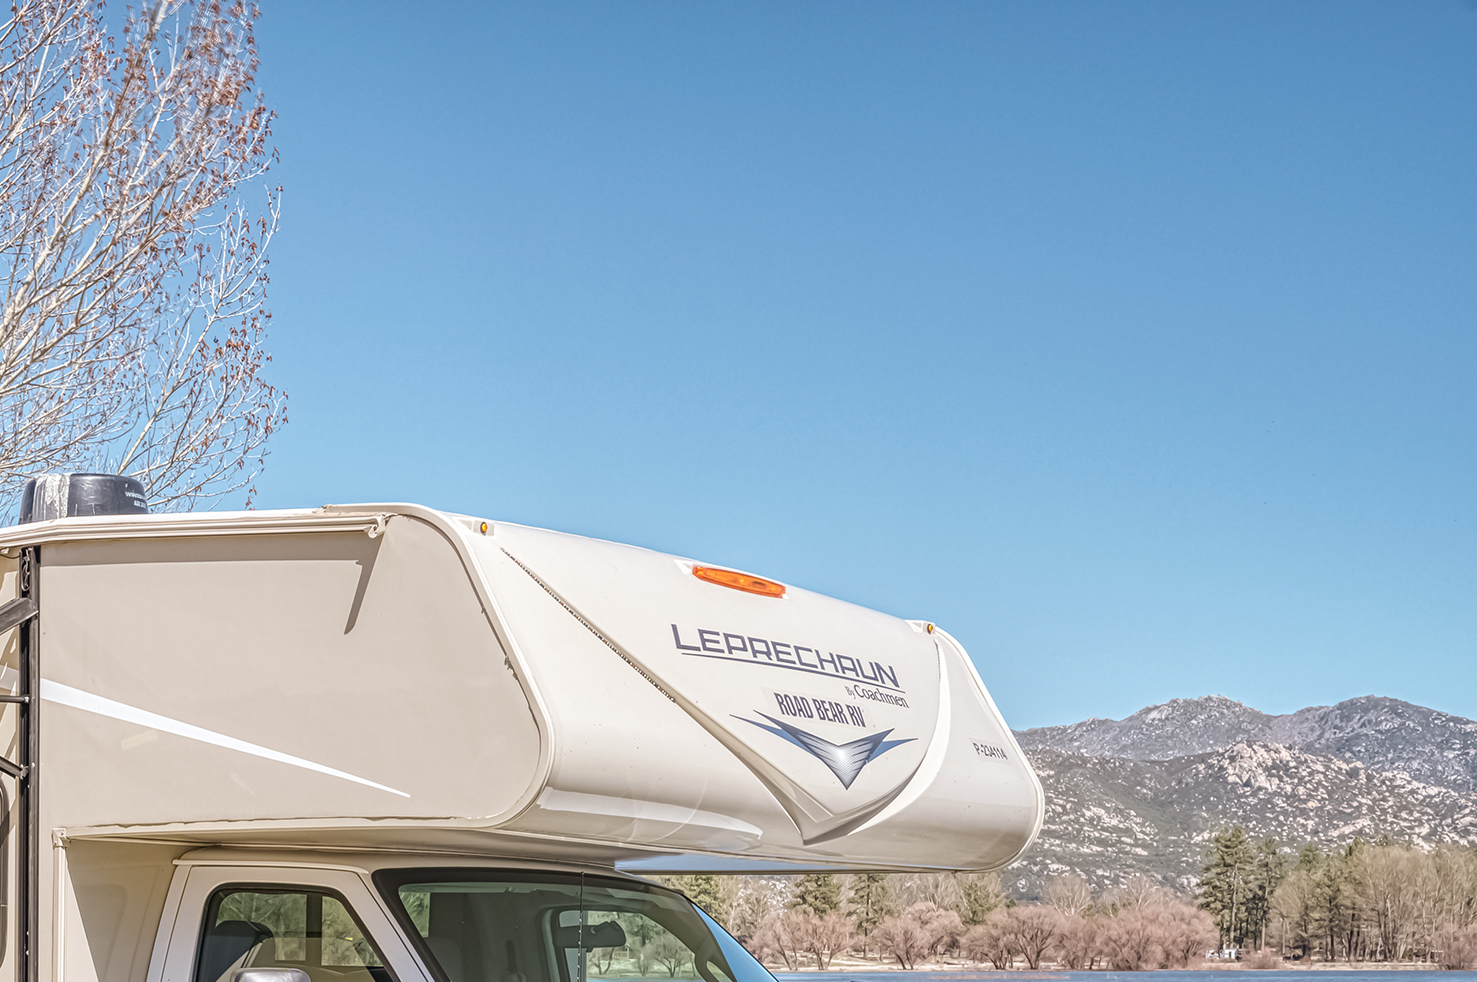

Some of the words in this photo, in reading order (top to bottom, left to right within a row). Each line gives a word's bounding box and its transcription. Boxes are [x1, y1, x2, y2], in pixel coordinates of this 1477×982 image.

[670, 623, 901, 689] LEPRECHAUN
[773, 692, 814, 719] ROAD
[814, 699, 850, 726] BEAR
[845, 703, 867, 728] RV
[853, 684, 910, 709] Coachmen
